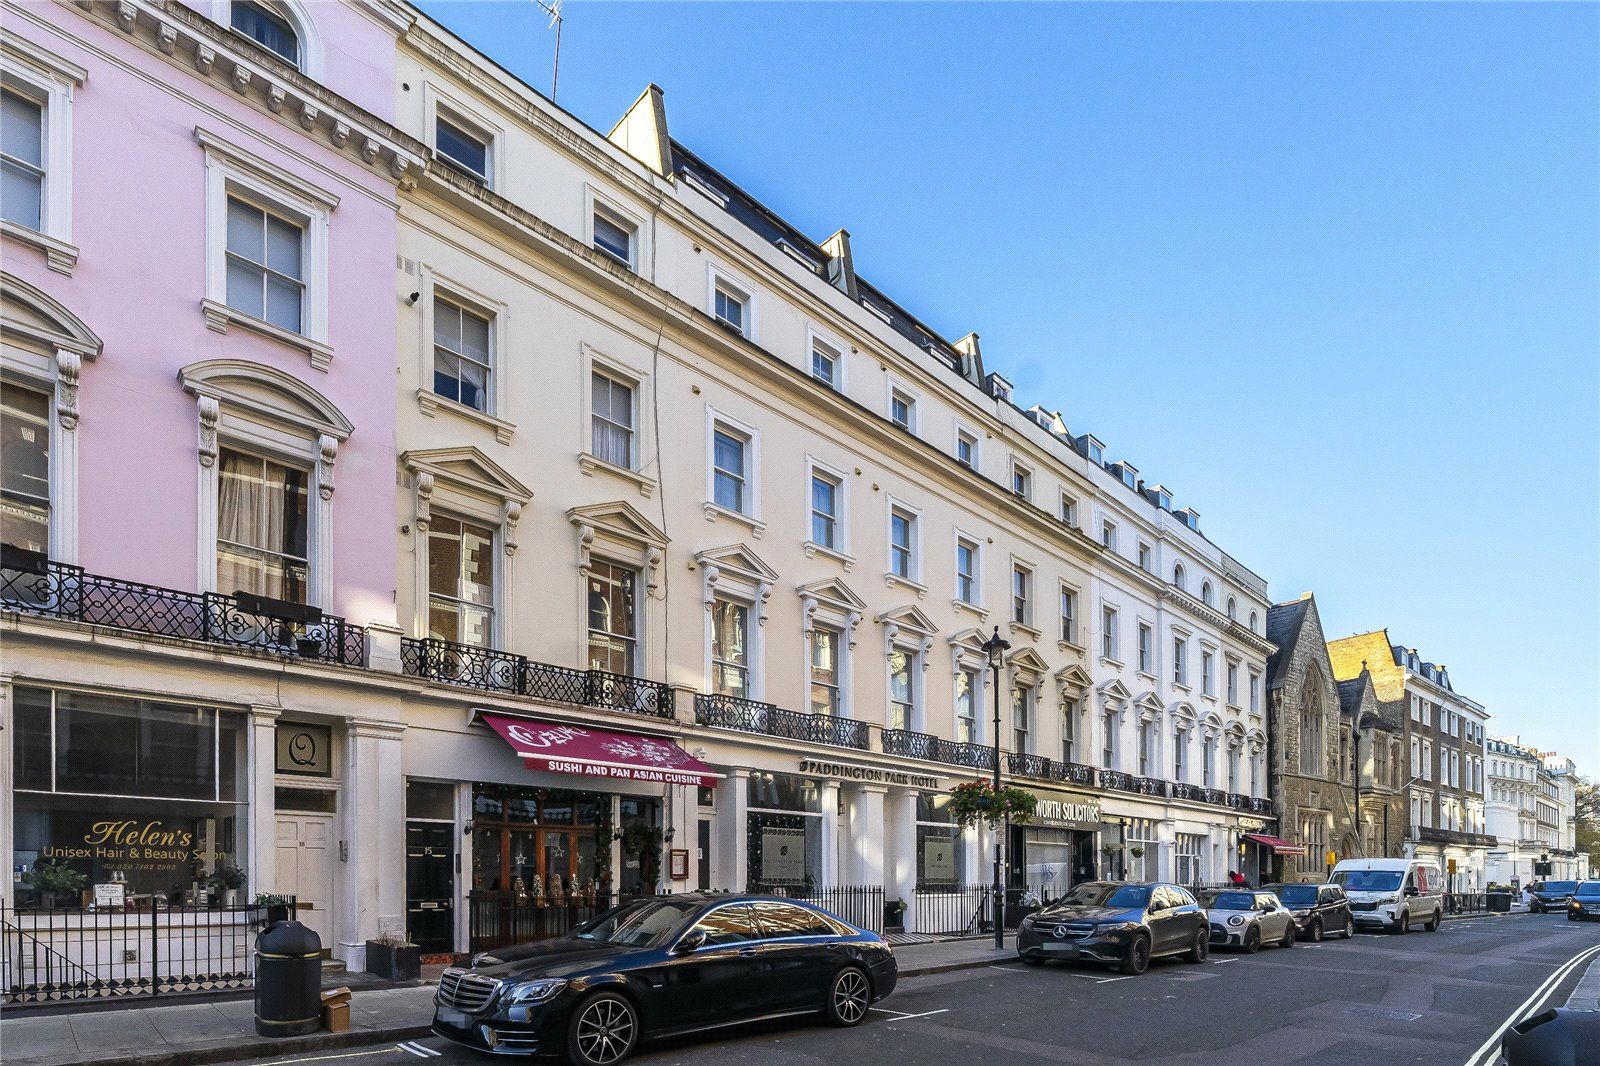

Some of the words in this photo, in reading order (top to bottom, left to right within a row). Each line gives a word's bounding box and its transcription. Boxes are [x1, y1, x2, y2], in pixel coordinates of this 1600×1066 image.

[289, 732, 316, 766] Q
[548, 761, 582, 773] SUSHI
[585, 765, 608, 775] AND
[610, 767, 631, 778] PAN
[633, 770, 663, 781] ASIAN
[665, 773, 702, 785] CUISINE
[809, 762, 882, 781] PADDINGTON
[885, 773, 908, 785] PARK
[911, 777, 939, 789] HOTEL
[1062, 802, 1099, 823] SOLICITORS
[84, 820, 193, 847] Helen's
[43, 846, 92, 859] Unisex
[96, 847, 124, 859] Hair
[129, 848, 140, 859] &
[144, 848, 189, 861] Beauty
[424, 846, 433, 855] 15
